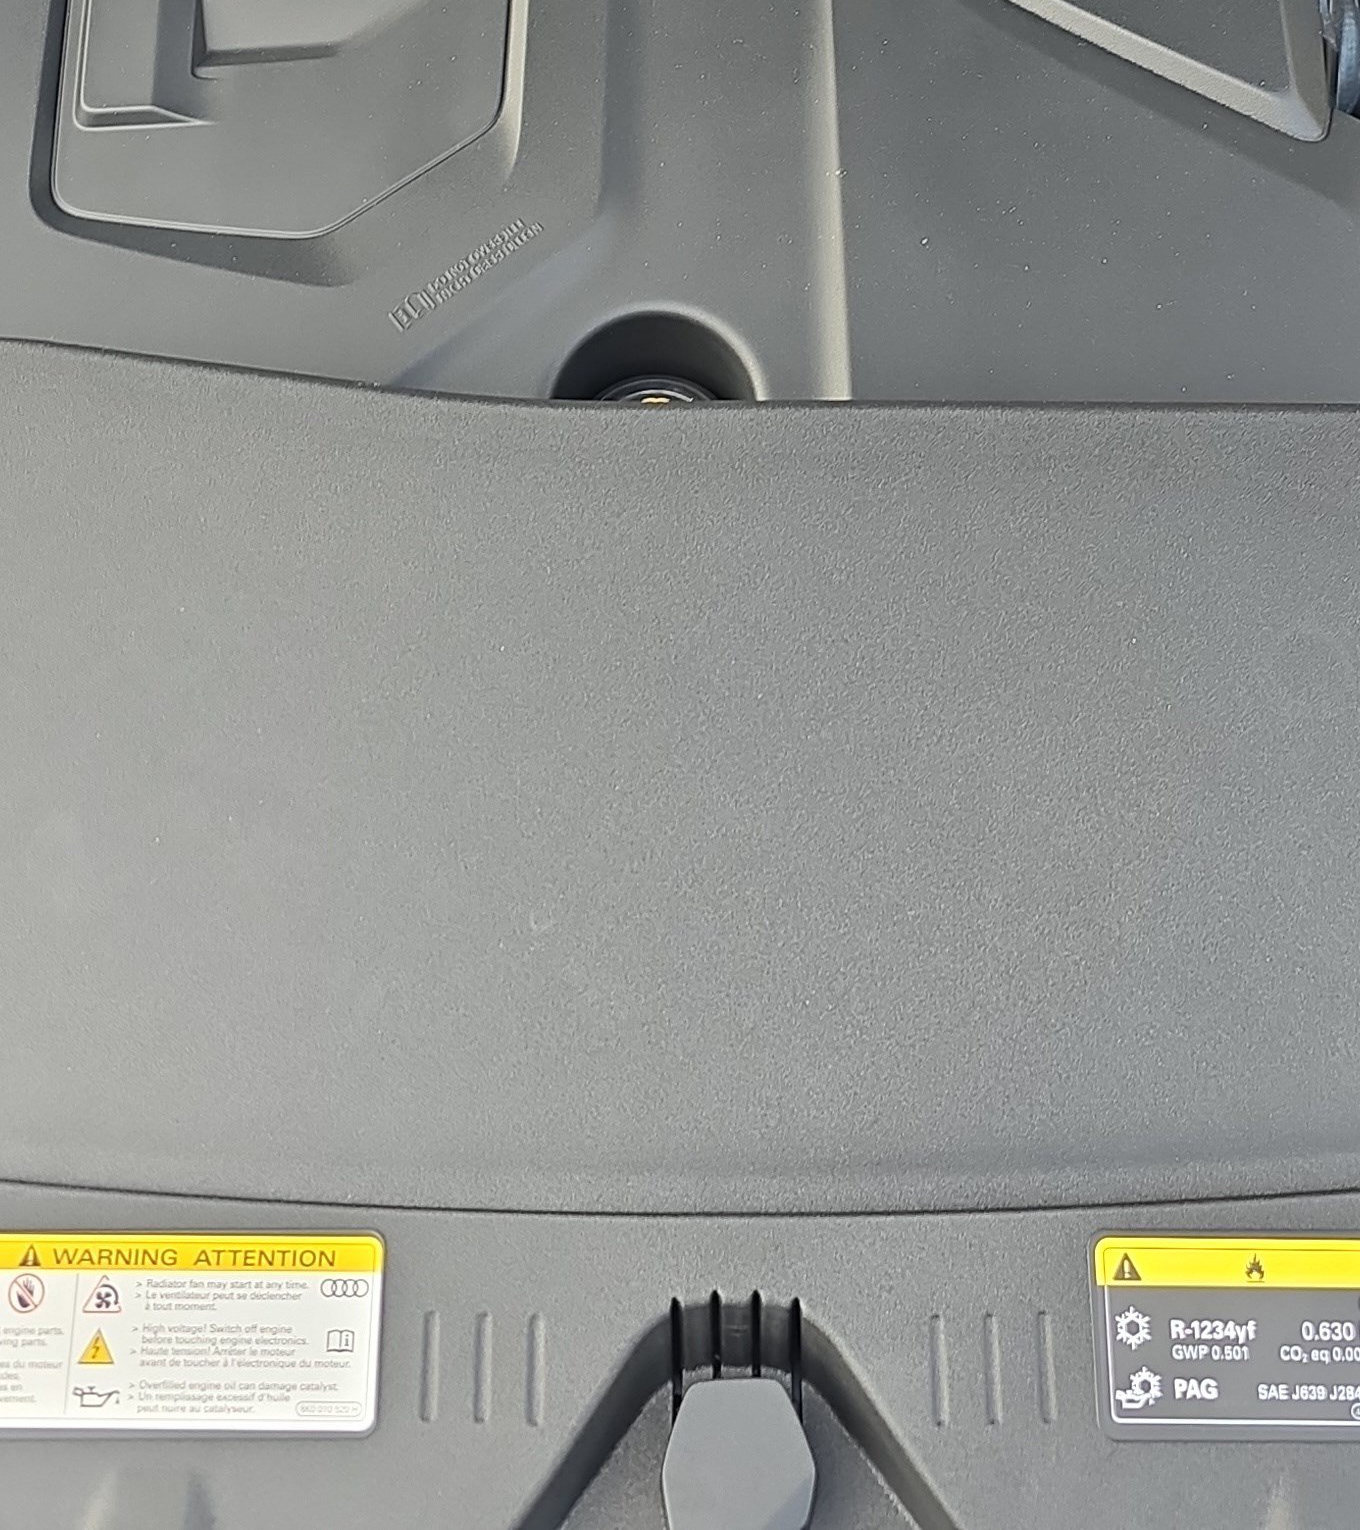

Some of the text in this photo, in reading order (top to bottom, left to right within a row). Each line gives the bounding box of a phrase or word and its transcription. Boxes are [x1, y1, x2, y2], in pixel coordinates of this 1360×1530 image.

[53, 1248, 337, 1268] WARNING ATTENTION
[146, 1278, 309, 1291] Radiator fan may start at any time.
[145, 1290, 157, 1300] Le
[159, 1290, 210, 1300] ventilateur
[212, 1291, 234, 1302] peut
[237, 1293, 247, 1301] se
[153, 1302, 172, 1311] tout
[174, 1302, 216, 1311] moment.
[3, 1327, 36, 1337] engine
[142, 1323, 293, 1336] High voltage! Switch off engine
[1170, 1320, 1256, 1344] R-1234yf
[1302, 1321, 1354, 1342] 0.630
[141, 1335, 308, 1346] before touching engine electronics.
[140, 1346, 169, 1356] Haute
[172, 1346, 210, 1356] tension!
[249, 1347, 258, 1357] le
[260, 1347, 295, 1357] moteur
[1172, 1345, 1209, 1361] GWP
[1212, 1345, 1250, 1361] 0.501
[1311, 1349, 1331, 1364] eq
[12, 1359, 26, 1369] du
[28, 1360, 63, 1369] moteur
[139, 1358, 166, 1368] avant
[169, 1358, 181, 1368] de
[183, 1358, 220, 1368] toucher
[299, 1359, 312, 1368] du
[314, 1359, 351, 1368] moteur.
[10, 1383, 23, 1391] en
[138, 1379, 339, 1393] Overfilled engine oil can damage catalyst.
[1174, 1378, 1219, 1400] PAG
[138, 1391, 290, 1403] Un remplissage excessif d'huile
[1257, 1385, 1289, 1400] SAE
[1292, 1385, 1326, 1401] J639
[136, 1404, 159, 1415] peut
[189, 1405, 201, 1414] au
